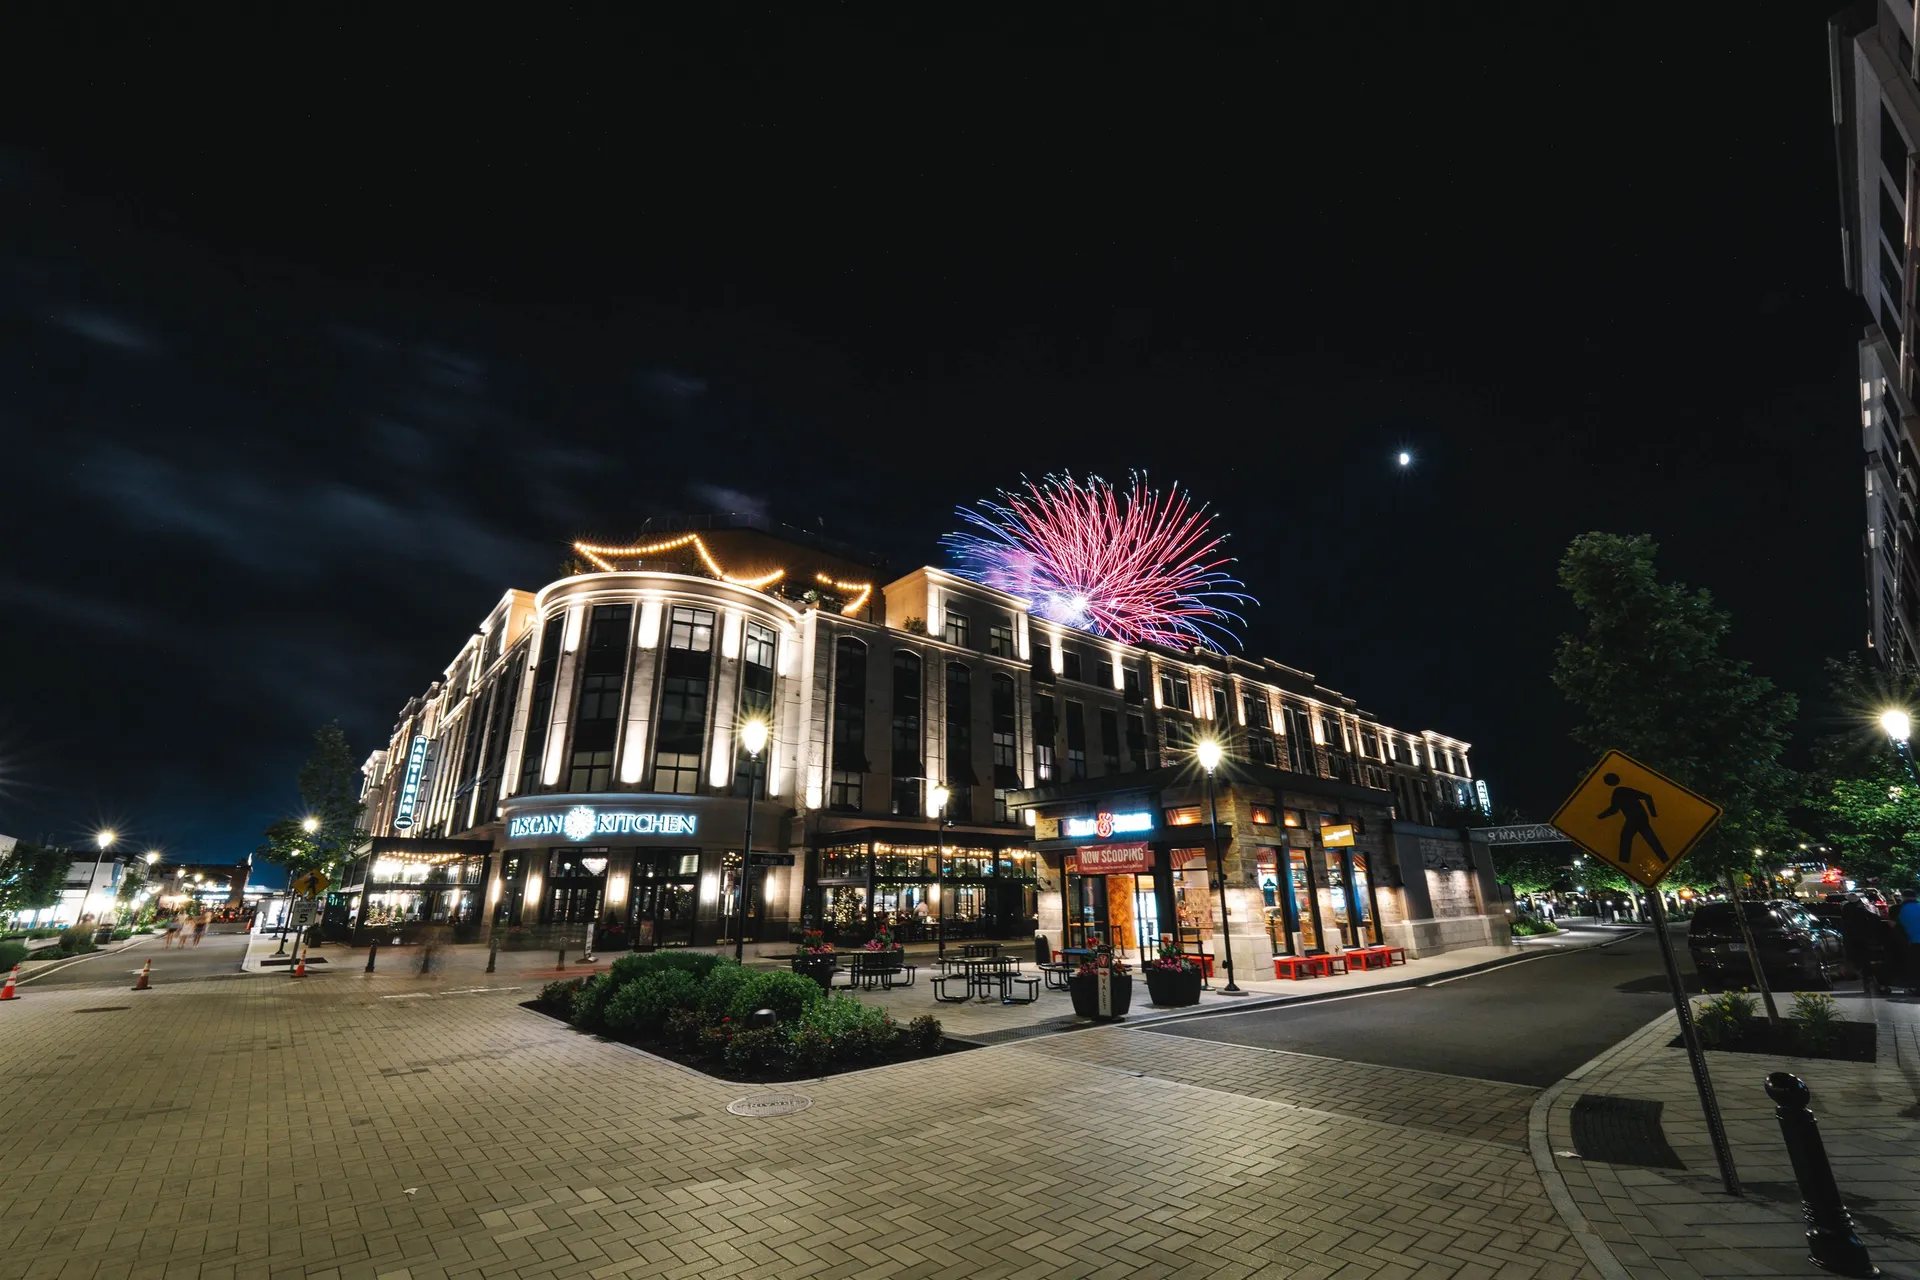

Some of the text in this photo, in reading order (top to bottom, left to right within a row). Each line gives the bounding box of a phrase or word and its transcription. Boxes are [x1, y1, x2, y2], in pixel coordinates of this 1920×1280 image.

[401, 744, 424, 814] ARTISAN
[597, 813, 696, 834] KITCHEN
[1081, 847, 1145, 864] NOW SCOOPING
[298, 913, 309, 923] 5
